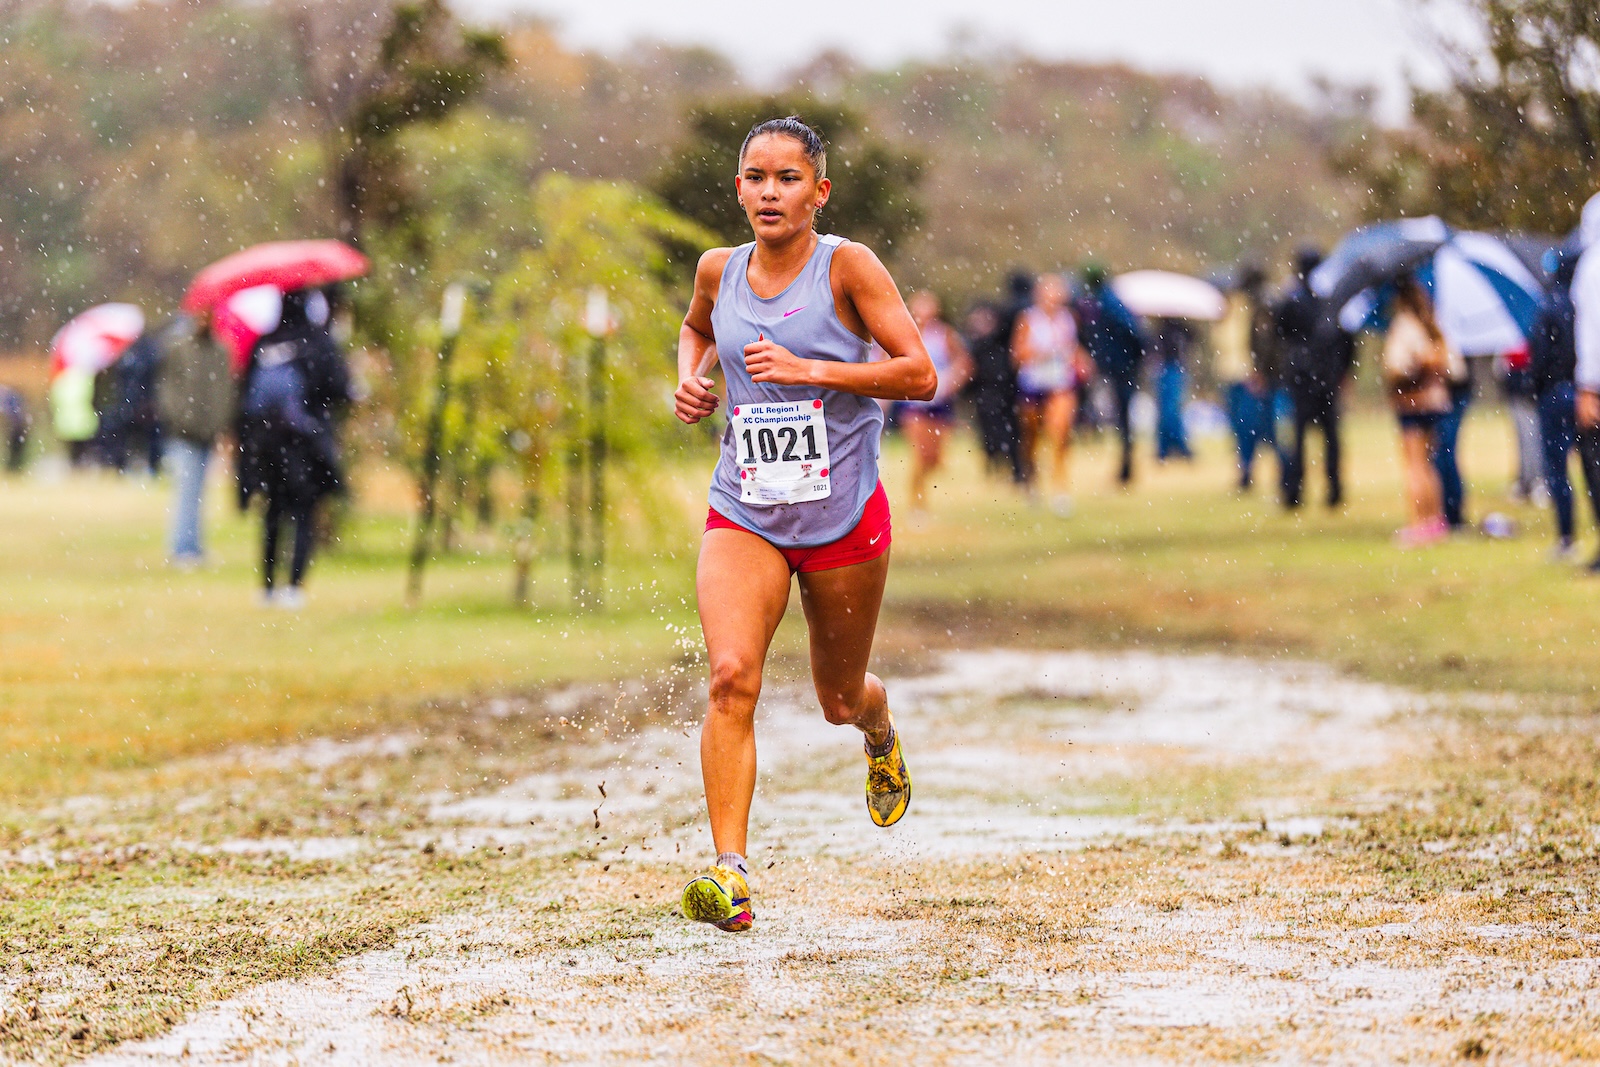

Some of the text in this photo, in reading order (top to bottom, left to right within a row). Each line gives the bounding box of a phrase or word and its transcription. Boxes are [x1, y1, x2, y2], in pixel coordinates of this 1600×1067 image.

[766, 406, 794, 414] Region
[754, 414, 811, 424] Championship
[742, 425, 821, 464] 1021
[813, 484, 827, 492] 1021
